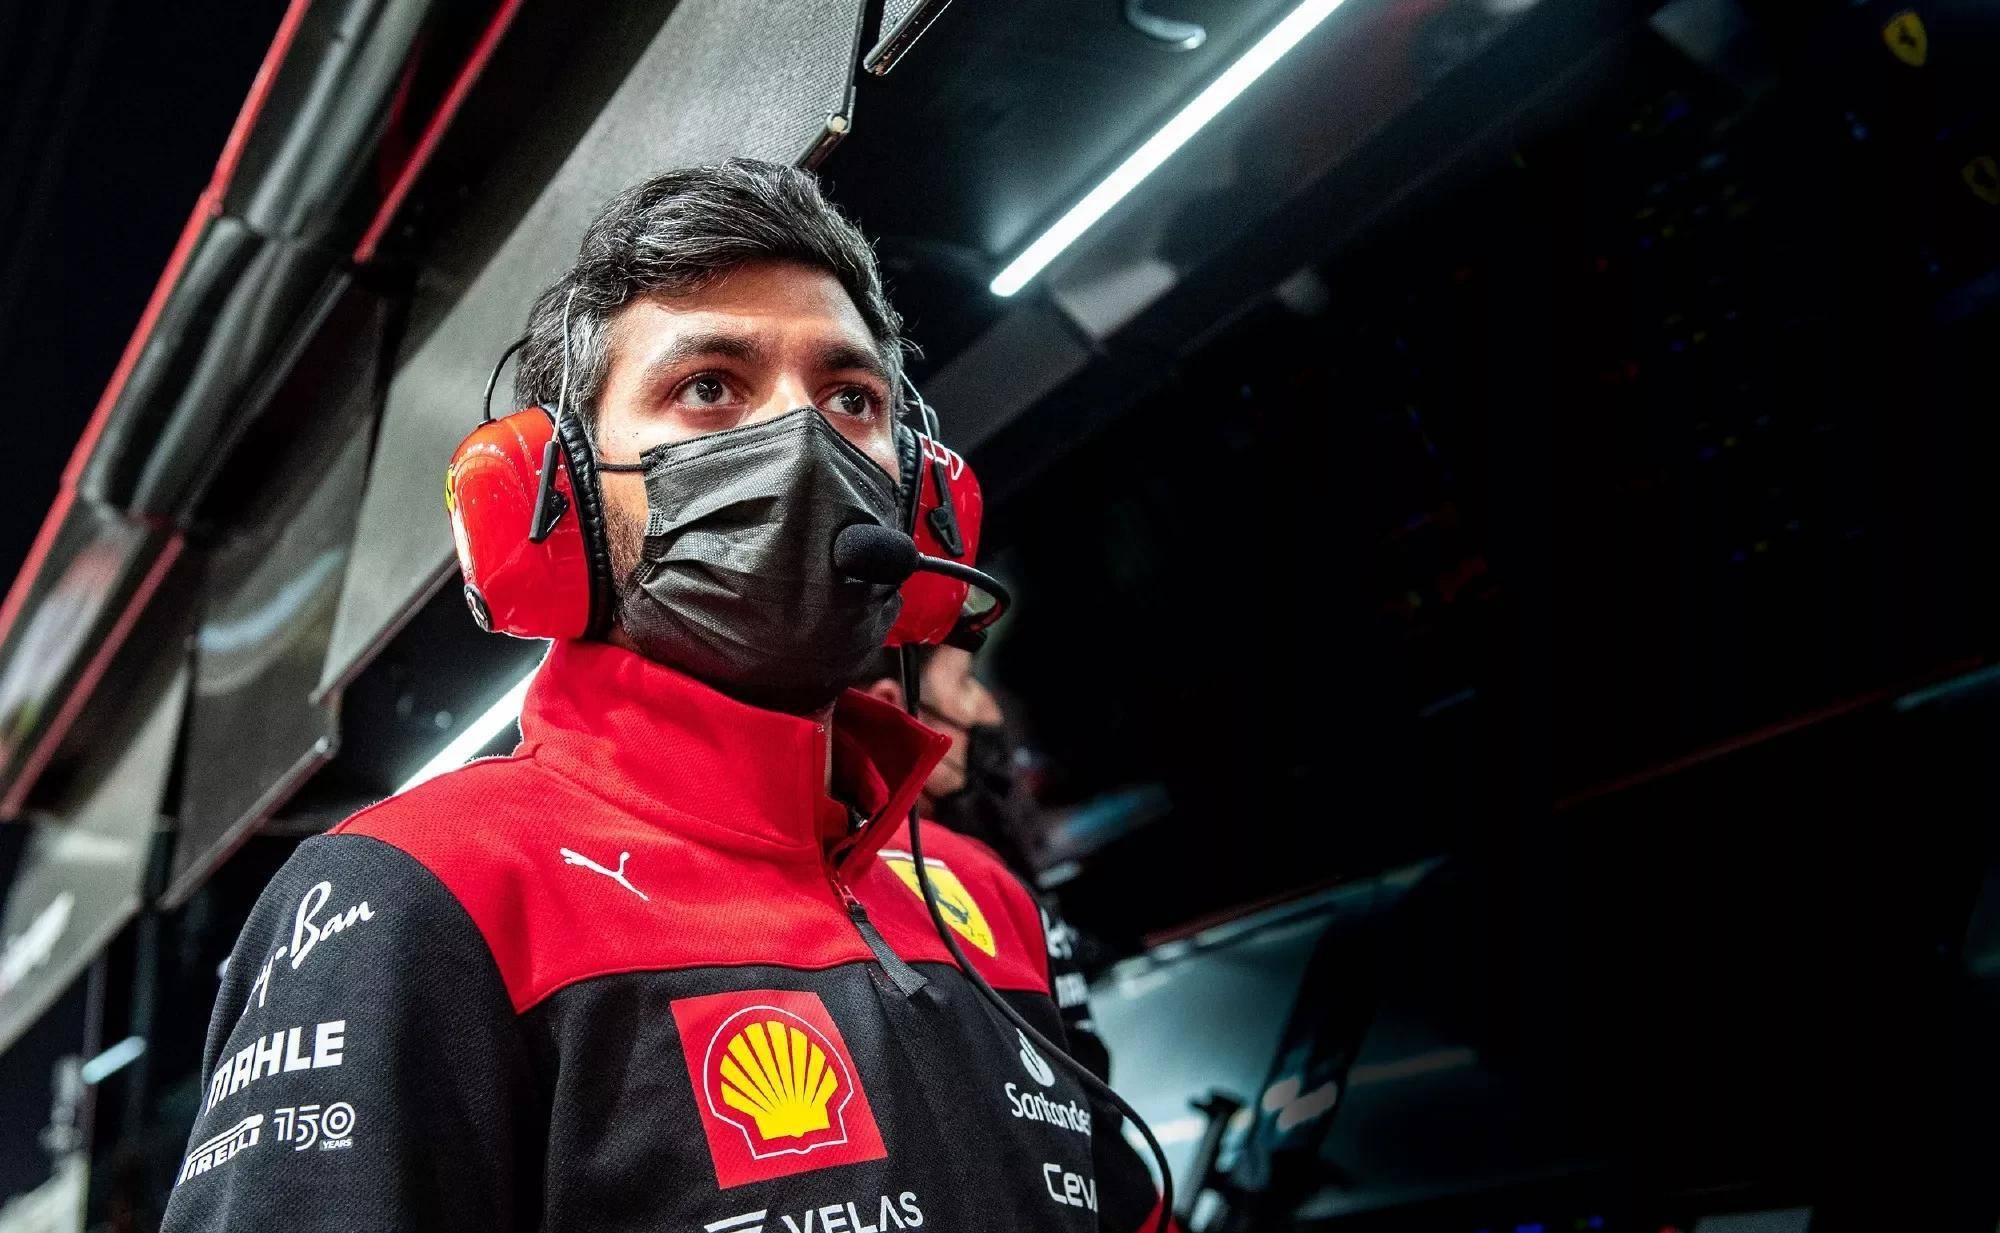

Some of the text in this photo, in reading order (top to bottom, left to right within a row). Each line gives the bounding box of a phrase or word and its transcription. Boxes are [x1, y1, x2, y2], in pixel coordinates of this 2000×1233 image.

[242, 880, 376, 1017] y-Ban
[204, 1019, 346, 1117] MAHLE
[176, 1113, 265, 1187] PIRELLI
[321, 1138, 353, 1150] YEARS
